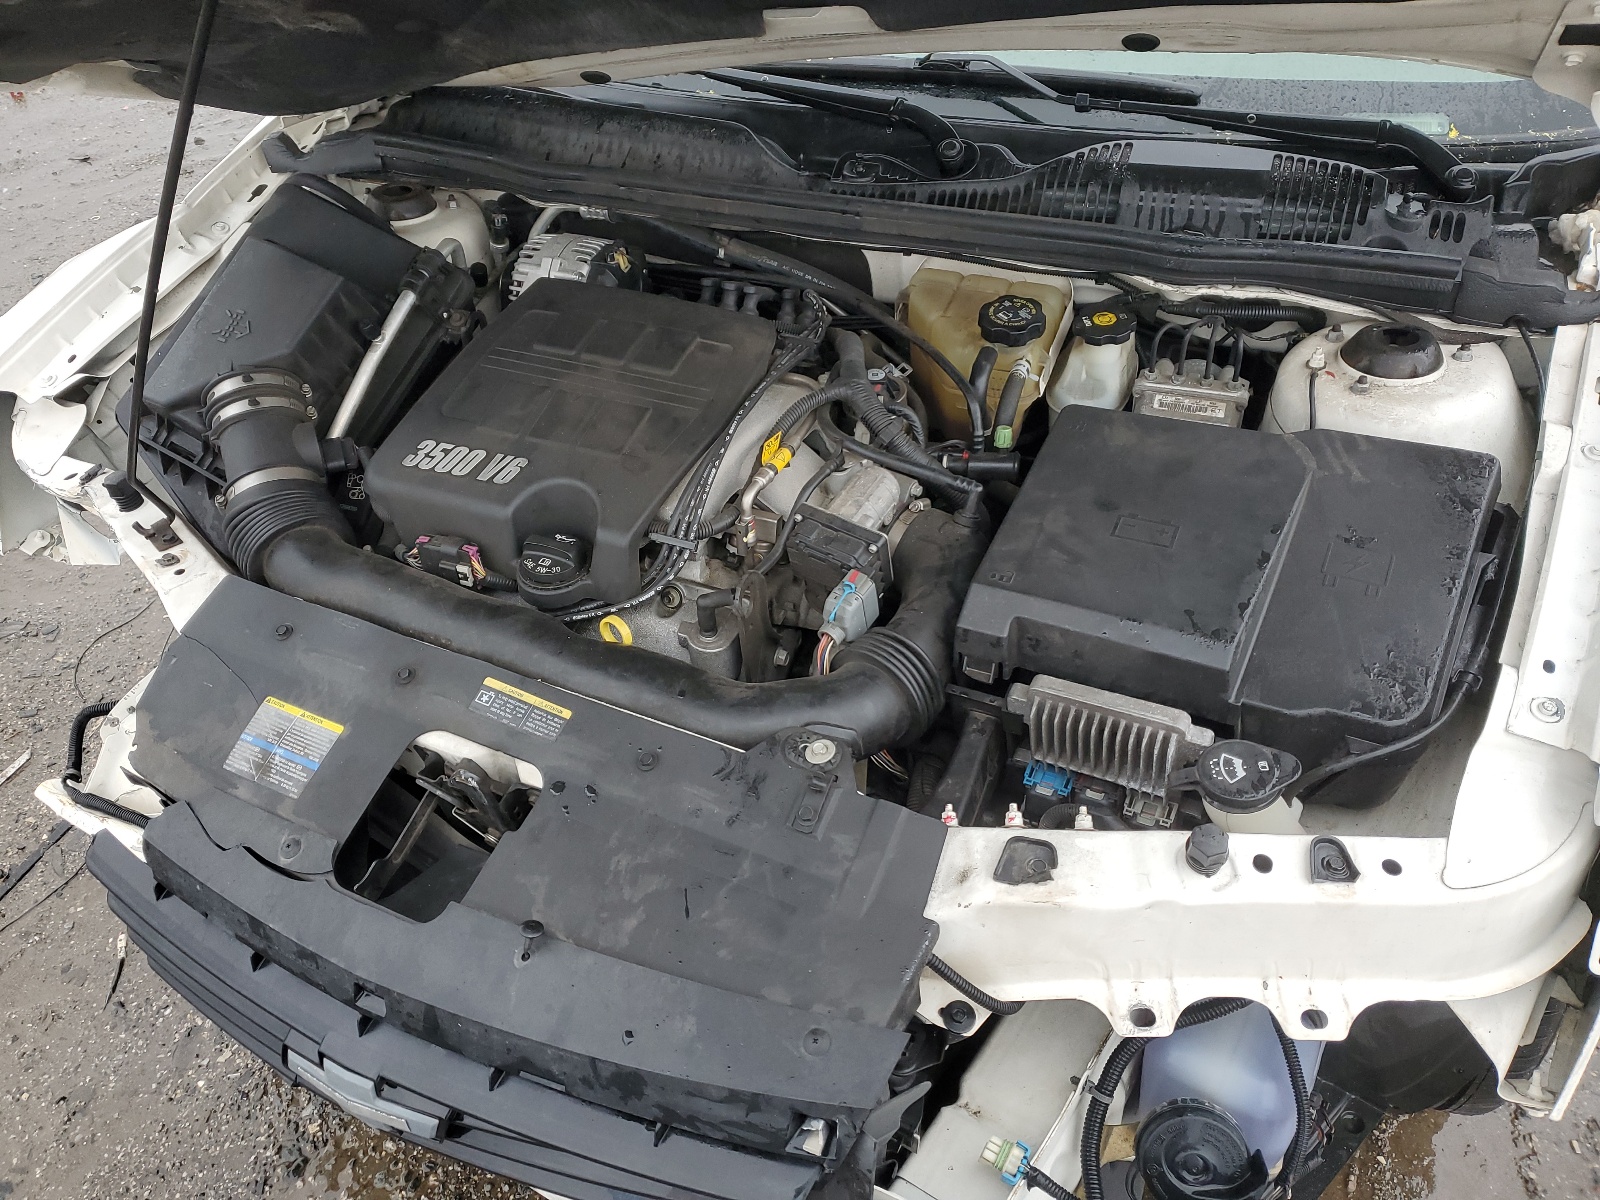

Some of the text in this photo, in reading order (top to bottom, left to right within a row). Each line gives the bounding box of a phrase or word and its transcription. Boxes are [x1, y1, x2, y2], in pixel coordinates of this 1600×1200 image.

[402, 439, 529, 484] 3500 V6
[523, 558, 561, 574] SAE 5W-30
